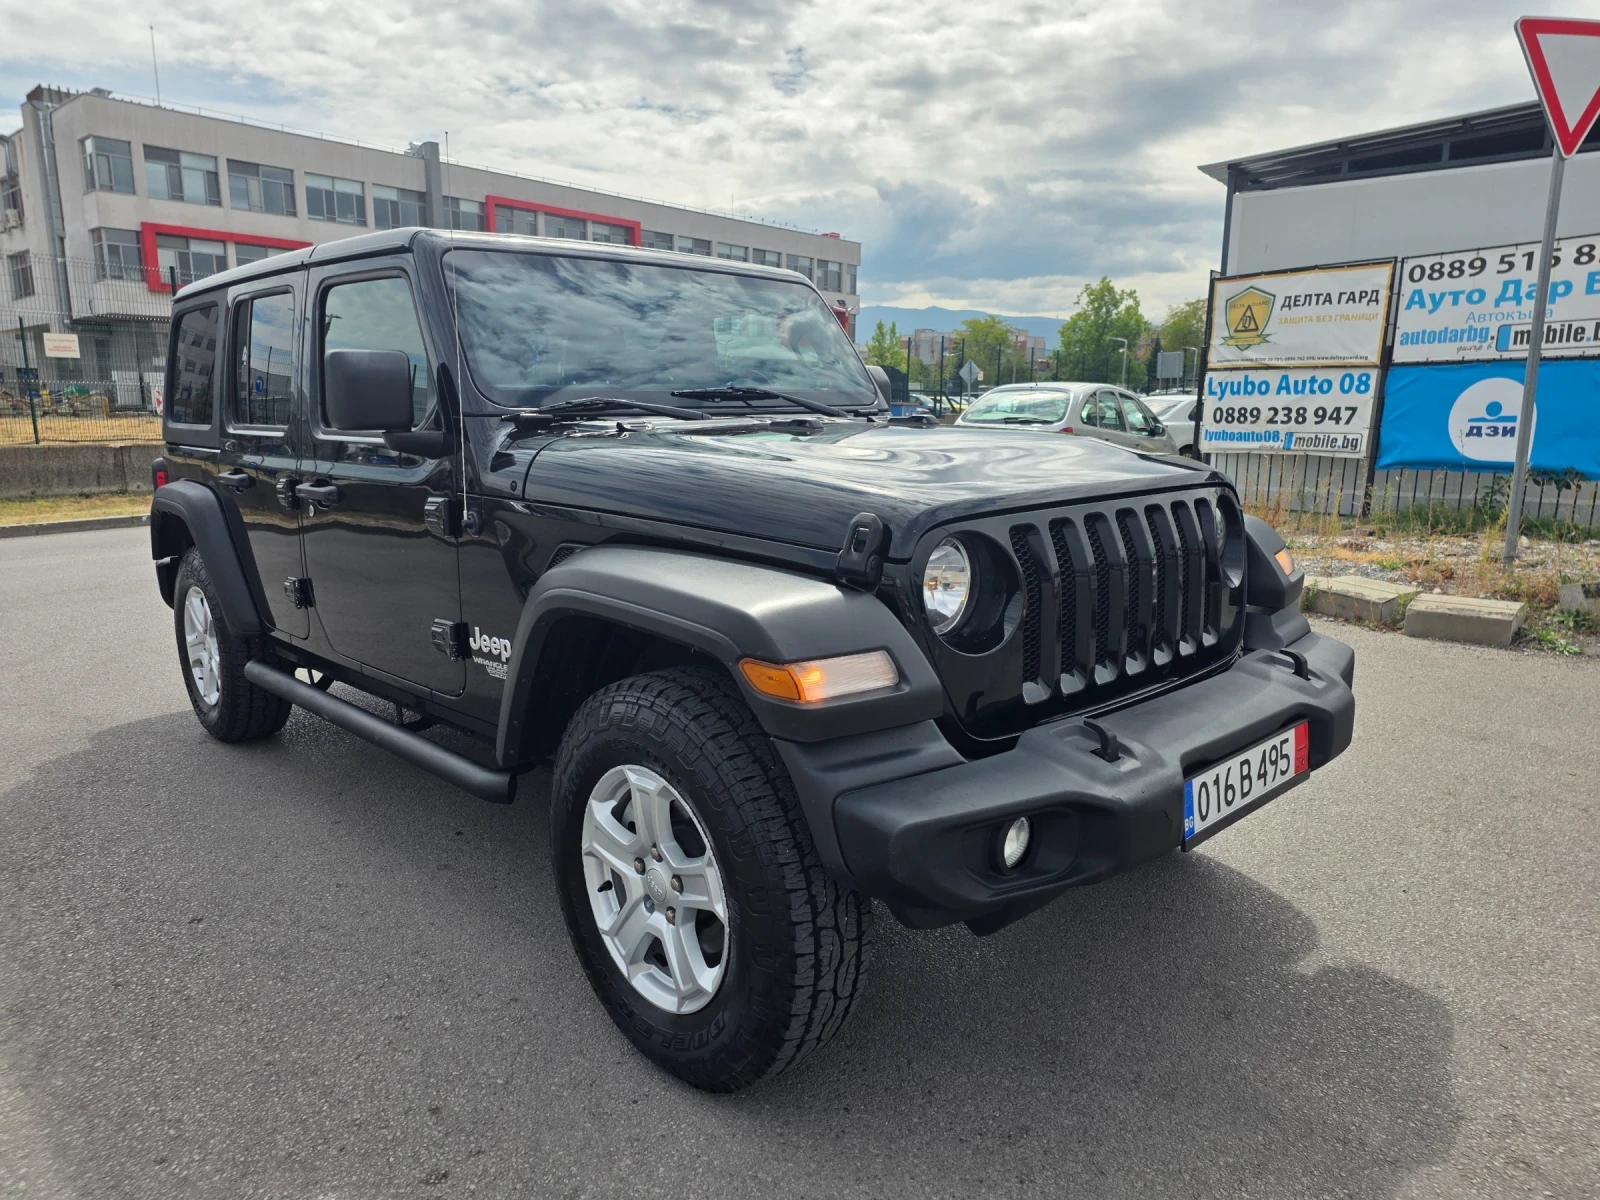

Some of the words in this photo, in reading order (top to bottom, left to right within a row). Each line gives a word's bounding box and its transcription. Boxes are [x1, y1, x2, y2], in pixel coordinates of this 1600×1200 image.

[1408, 256, 1487, 283] 0889
[1573, 243, 1600, 266] 8
[1280, 292, 1333, 311] ДЕЛТА
[1337, 289, 1380, 306] ГАРД
[1404, 288, 1487, 315] Ауто
[1494, 278, 1573, 309] Дар
[1278, 314, 1315, 325] ЗАЩИТА
[1315, 313, 1333, 323] БЕЗ
[1334, 312, 1379, 323] ГРАНИЦИ
[1400, 324, 1495, 347] autodarbg.
[1208, 374, 1270, 402] Lyubo
[1275, 374, 1333, 395] Auto
[1339, 372, 1371, 395] 08
[1213, 406, 1261, 425] 0889
[1266, 406, 1307, 425] 238
[1313, 406, 1358, 426] 947
[1466, 425, 1516, 438] ДЗИ
[469, 626, 512, 663] Jeep
[1184, 815, 1195, 832] BG
